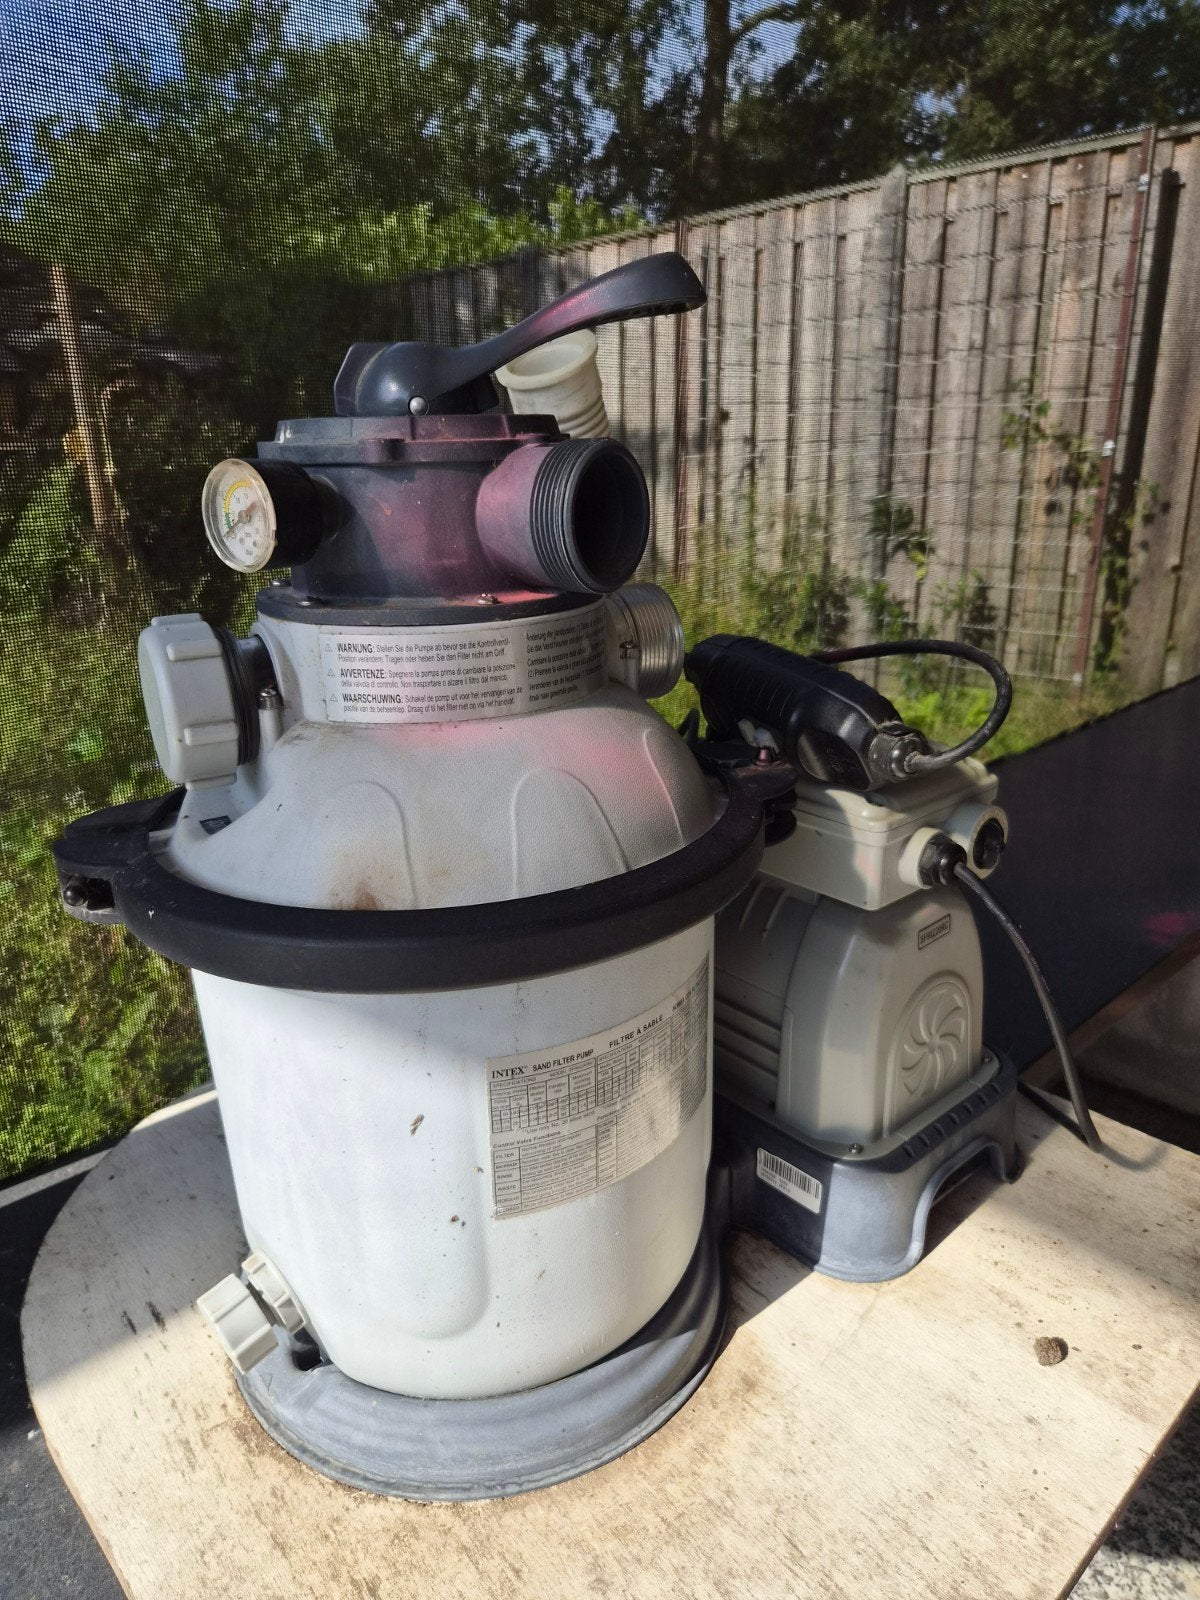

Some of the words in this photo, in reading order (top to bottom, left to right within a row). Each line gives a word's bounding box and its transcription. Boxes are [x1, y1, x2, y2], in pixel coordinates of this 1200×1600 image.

[337, 643, 374, 653] WARNUNG:
[377, 644, 394, 652] Stellen
[395, 644, 403, 652] Sie
[415, 644, 434, 653] Pumpe
[385, 655, 403, 664] Tragen
[418, 654, 435, 662] heben
[458, 652, 470, 660] Filter
[472, 651, 484, 659] nicht
[340, 668, 387, 679] AVVERTENZE:
[389, 670, 413, 679] Spegnere
[421, 670, 439, 678] pompa
[440, 669, 455, 677] prima
[463, 666, 486, 675] cambiare
[493, 664, 516, 673] posizione
[413, 680, 441, 689] trasportare
[342, 693, 403, 703] WAARSCHUWING:
[405, 694, 425, 703] Schakel
[427, 694, 434, 702] de
[481, 688, 506, 698] vervangen
[408, 705, 423, 714] Draag
[609, 1031, 634, 1048] FILTRE
[636, 1027, 641, 1035] À
[643, 1014, 663, 1032] SABLE
[532, 1061, 551, 1072] SAND
[553, 1055, 575, 1067] FILTER
[576, 1048, 594, 1060] PUMP
